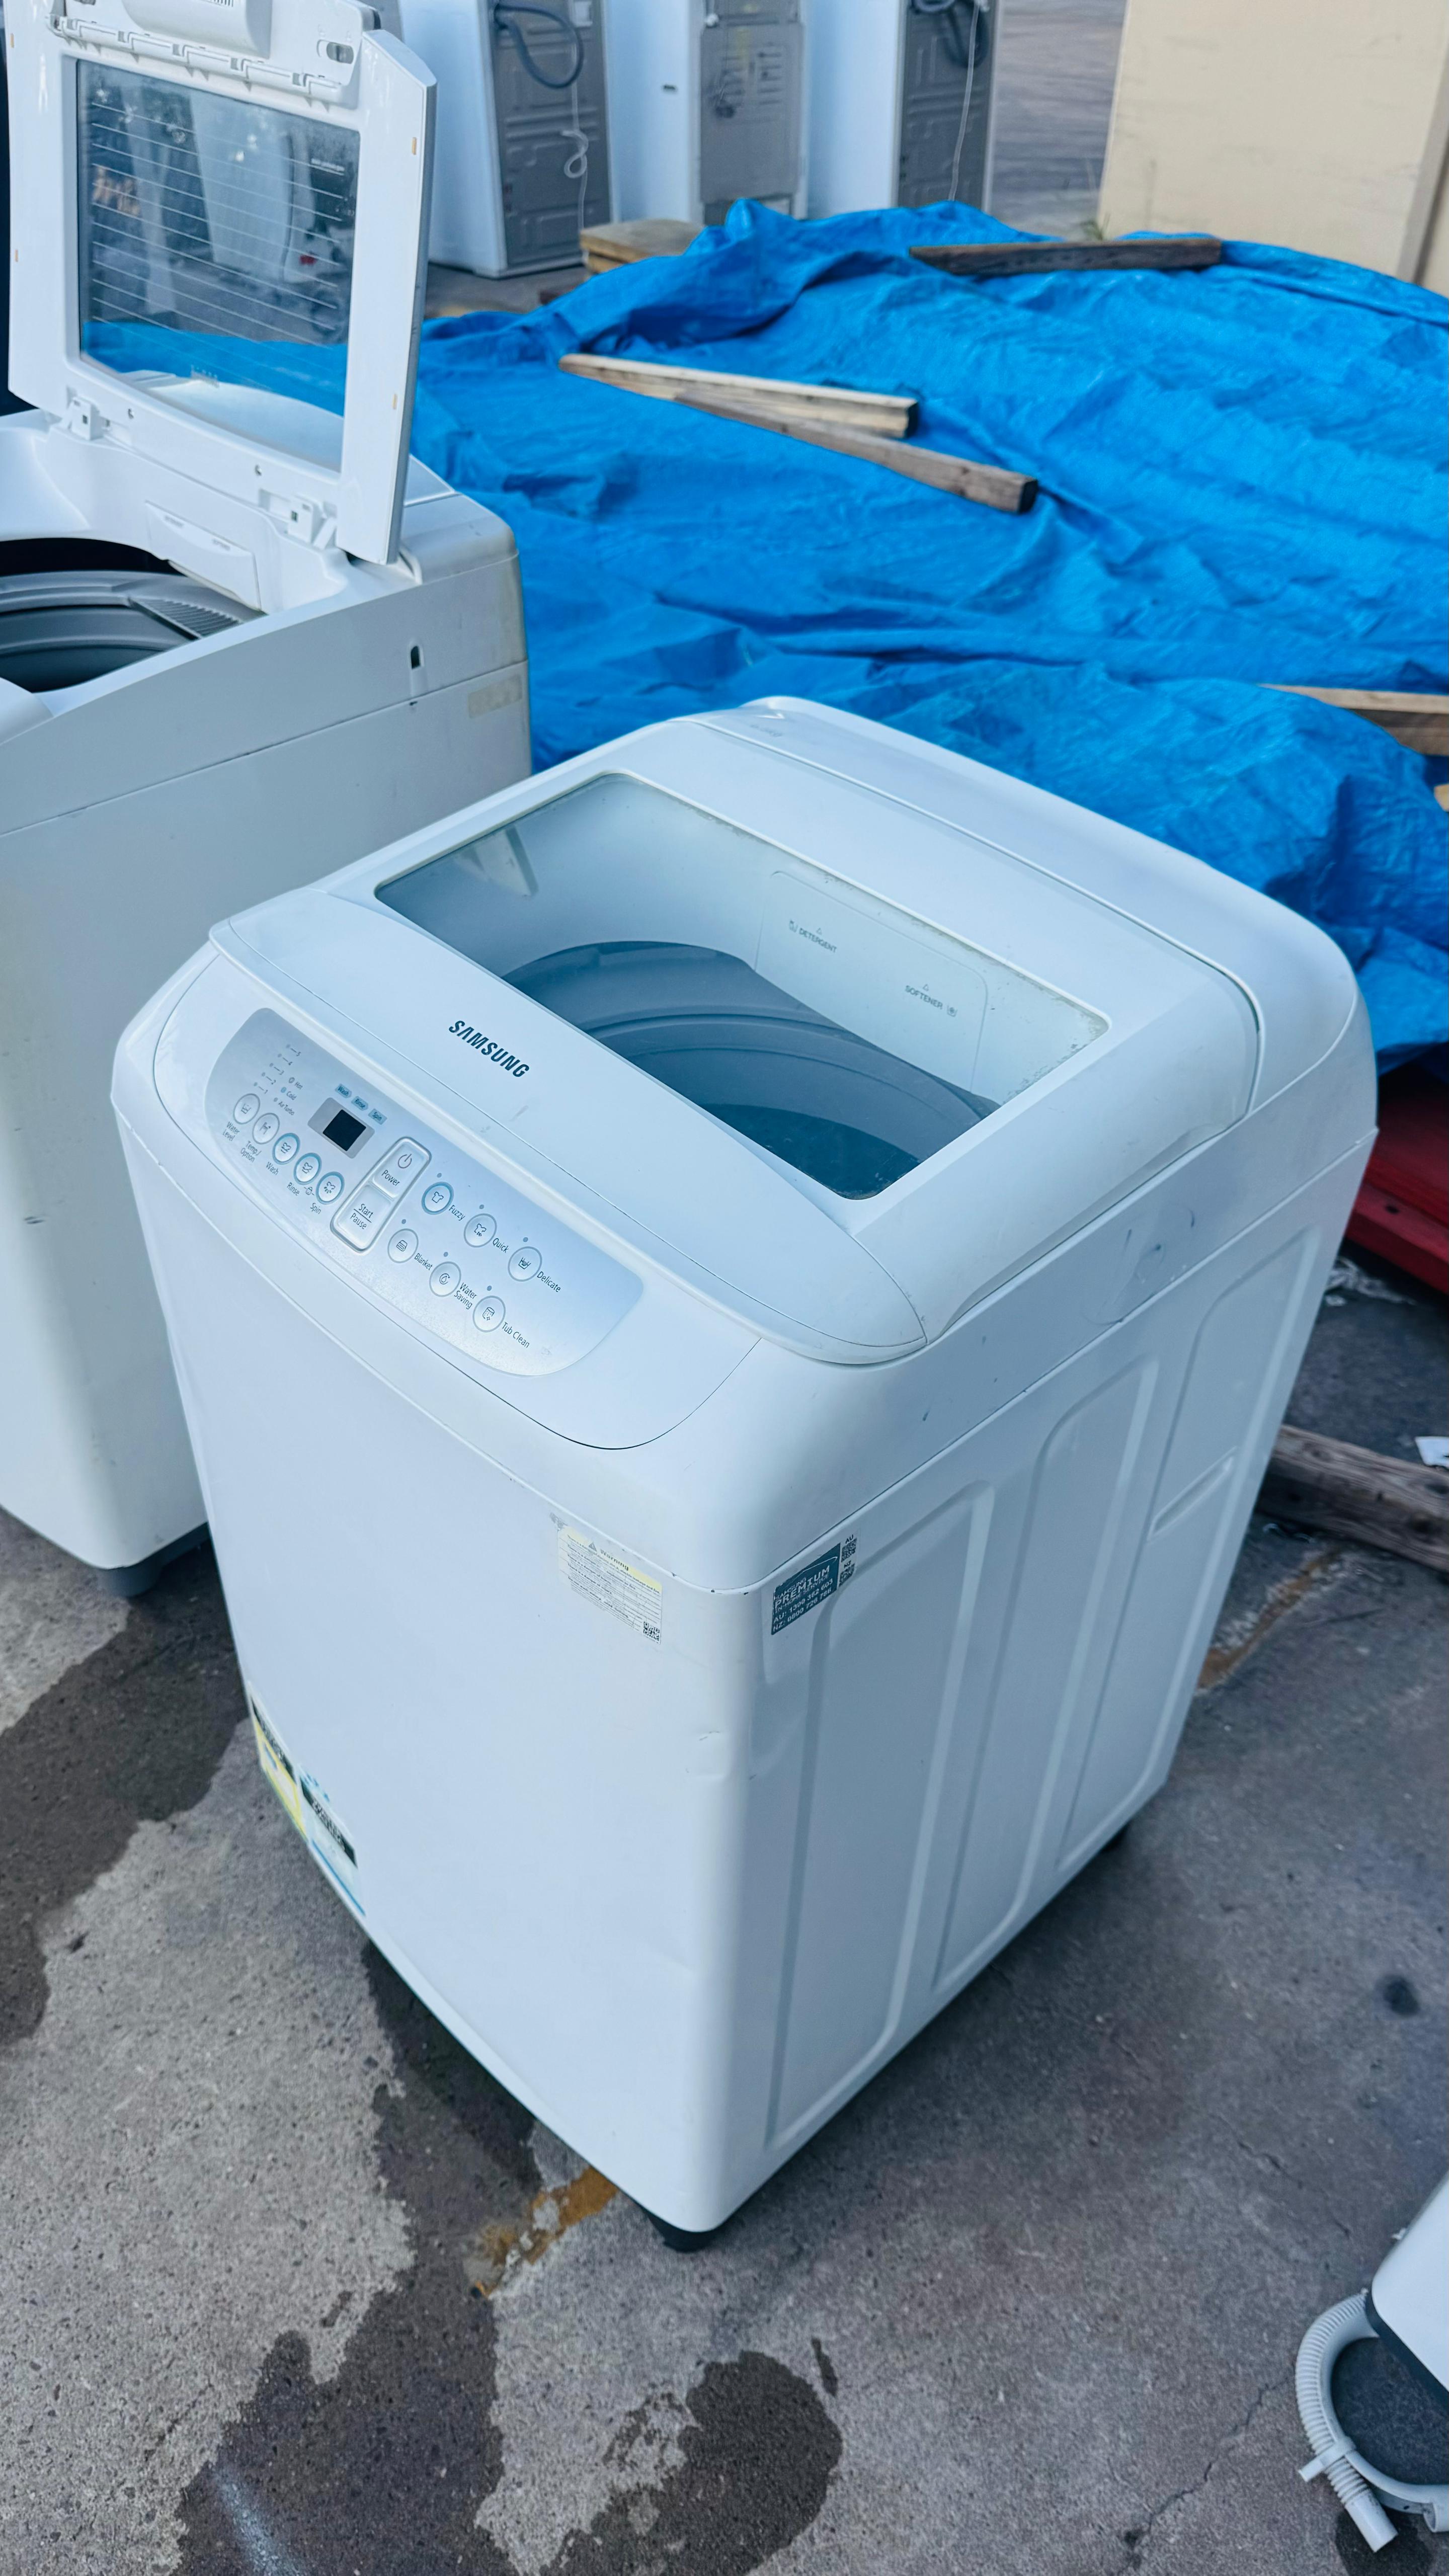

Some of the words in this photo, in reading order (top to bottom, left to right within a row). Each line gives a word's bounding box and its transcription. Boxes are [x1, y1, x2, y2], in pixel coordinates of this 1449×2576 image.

[799, 928, 837, 953] DETERGENT
[905, 985, 943, 1010] SOFTENER
[449, 1020, 530, 1077] SAMSUNG
[286, 1091, 297, 1100] Cold
[222, 1130, 235, 1142] Level
[226, 1121, 240, 1135] Water
[240, 1148, 256, 1163] Option
[266, 1162, 279, 1175] Wash
[381, 1169, 400, 1186] Power
[287, 1182, 300, 1196] Rinse
[310, 1202, 321, 1215] Spin
[358, 1203, 373, 1219] Start
[448, 1204, 466, 1221] Fuzzy
[350, 1213, 367, 1230] Pause
[492, 1237, 509, 1253] Quick
[414, 1253, 433, 1271] Blanket
[537, 1271, 561, 1293] Delicate
[459, 1282, 477, 1300] Water
[454, 1290, 473, 1310] Saving
[502, 1322, 513, 1334] Tub
[513, 1331, 530, 1348] Clean
[845, 1534, 853, 1544] AU
[775, 1565, 830, 1608] PREMIUM
